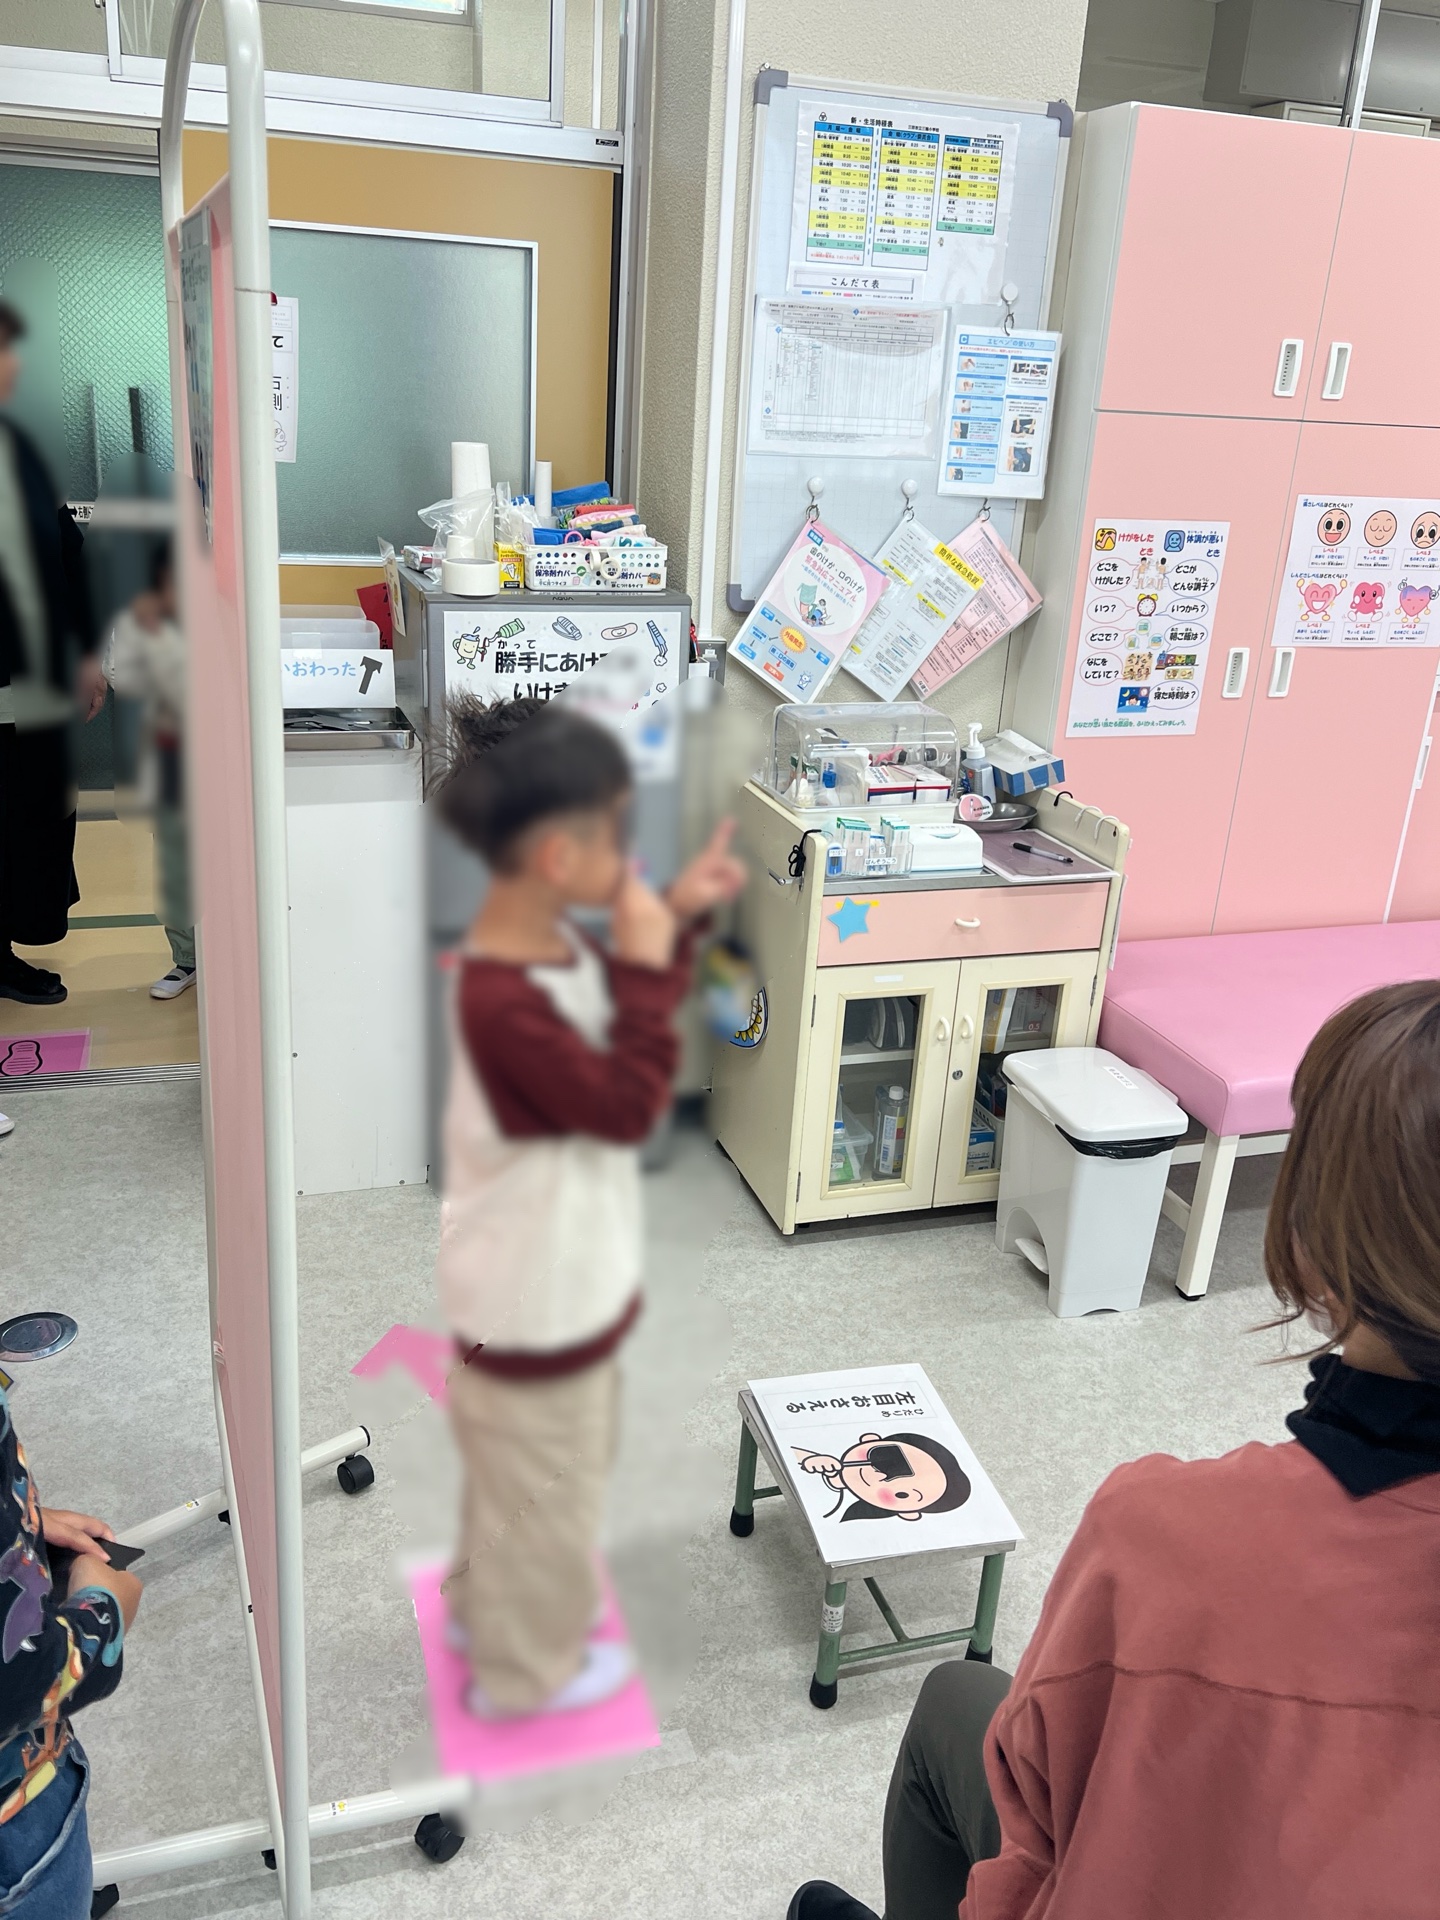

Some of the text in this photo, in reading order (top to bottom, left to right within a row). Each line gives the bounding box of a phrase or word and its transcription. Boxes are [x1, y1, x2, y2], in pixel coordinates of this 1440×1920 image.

[831, 277, 880, 289] こんだて表
[1118, 533, 1154, 542] けがをした
[1186, 535, 1223, 543] 体調が悪い
[1140, 548, 1153, 556] とき
[1206, 549, 1220, 557] とき
[810, 546, 864, 593] 歯のけが・口のけが
[938, 547, 980, 586] 簡単な救急処置
[1097, 562, 1118, 572] どこを
[1175, 565, 1196, 574] どこが
[535, 569, 576, 577] 保冷剤カバー
[805, 555, 856, 602] 緊急対応マニュアル
[1095, 576, 1130, 585] けがした？
[1173, 582, 1215, 591] どんな調子？
[1094, 604, 1116, 613] いつ？
[1172, 605, 1205, 613] いつから？
[1090, 633, 1118, 641] どこで？
[1169, 632, 1204, 641] 朝ご飯は？
[497, 640, 537, 650] かって
[495, 652, 608, 674] 勝手にあけ
[1086, 658, 1108, 666] なにを
[1084, 670, 1119, 679] していて？
[1154, 691, 1196, 700] 寝た時刻は？
[786, 1391, 915, 1413] 左目おさえる
[881, 1409, 924, 1418] ひだりめ
